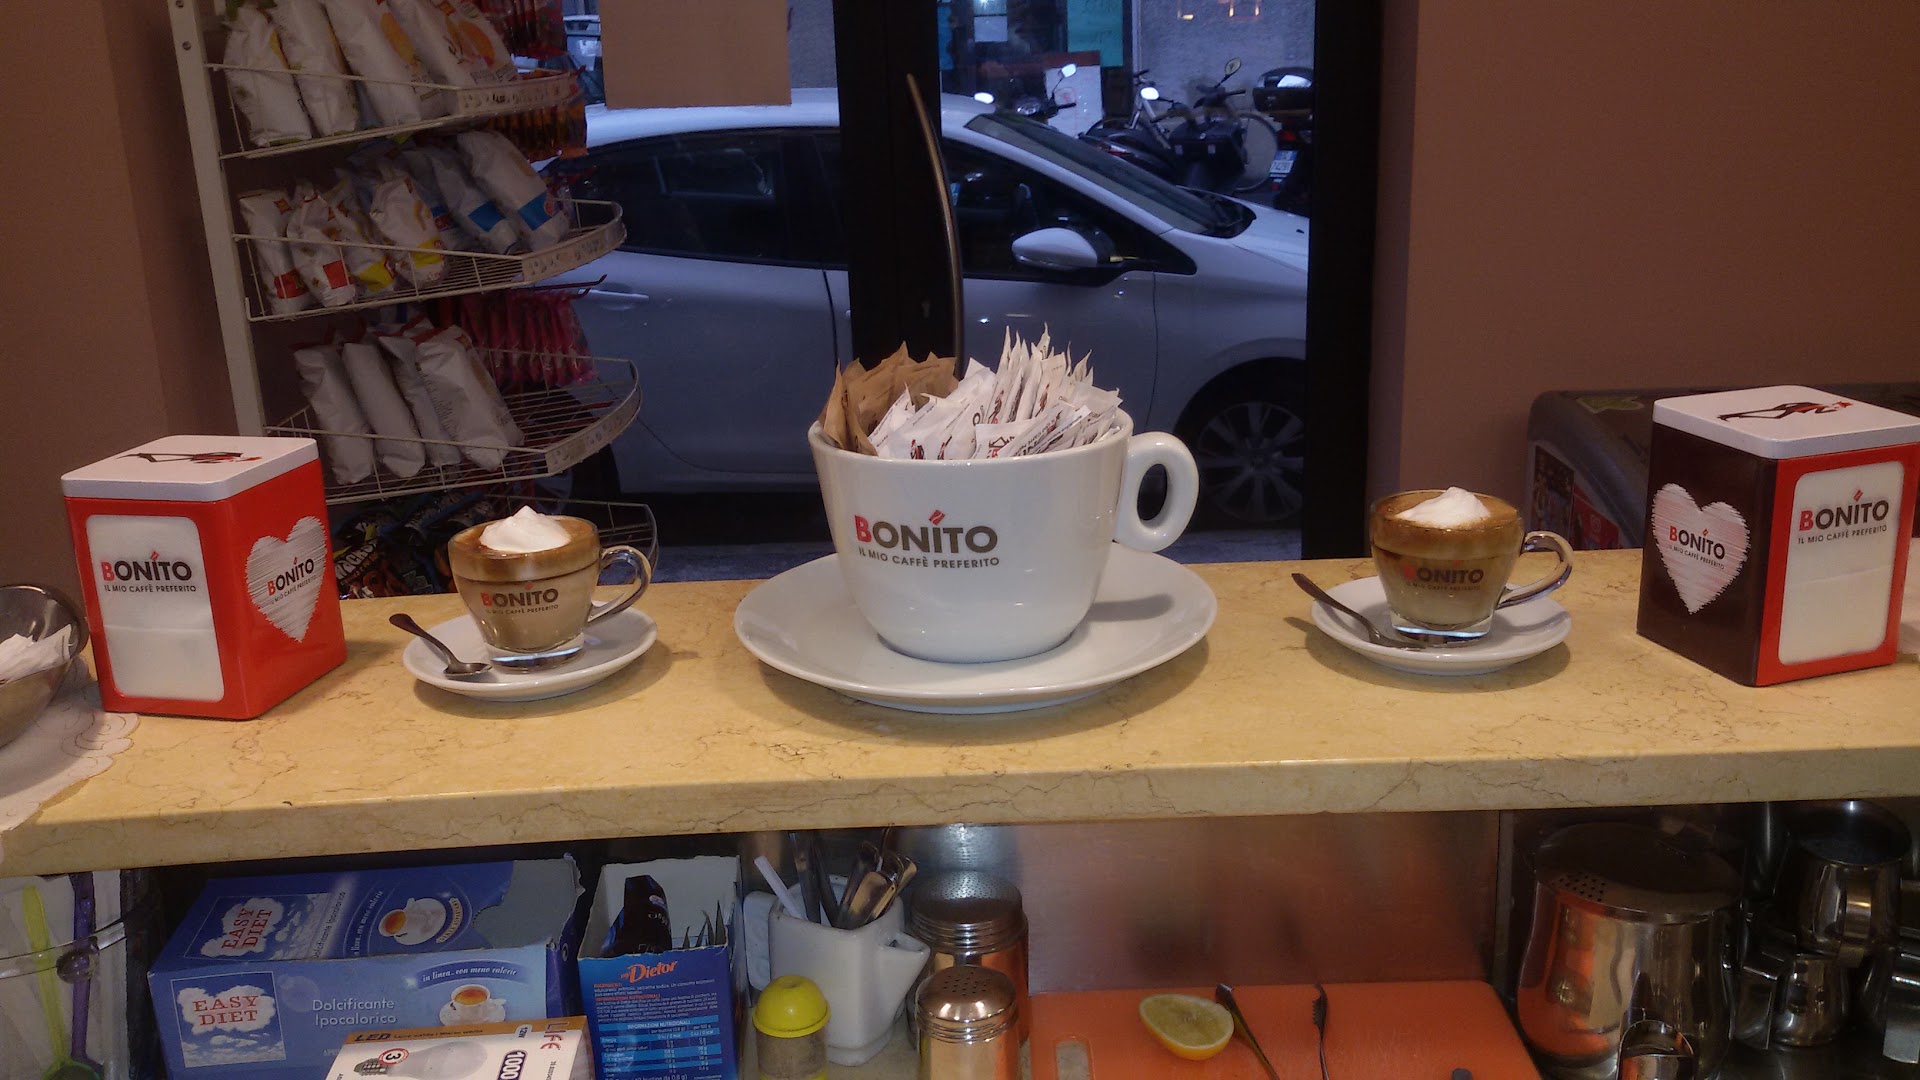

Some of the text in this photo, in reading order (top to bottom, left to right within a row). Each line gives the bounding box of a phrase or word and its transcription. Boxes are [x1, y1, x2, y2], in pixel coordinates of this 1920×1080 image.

[854, 509, 998, 554] BONITO
[1807, 534, 1824, 543] MIO
[1826, 529, 1849, 541] CAFFÈ
[1851, 524, 1888, 537] PREFERITO
[100, 551, 192, 581] BONITO
[858, 546, 1000, 569] IL MIO CAFFÈ PREFERITO
[104, 583, 197, 593] IL MIO CAFFÈ PREFERITO
[526, 604, 559, 613] PREFERITO
[221, 907, 254, 949] EASY
[242, 908, 272, 948] DIET
[627, 960, 678, 984] Dietor
[192, 995, 259, 1013] EASY
[311, 998, 396, 1012] Dolcificante
[199, 1010, 258, 1027] DIET
[314, 1012, 398, 1028] Ipocalorico
[354, 1032, 392, 1043] LED
